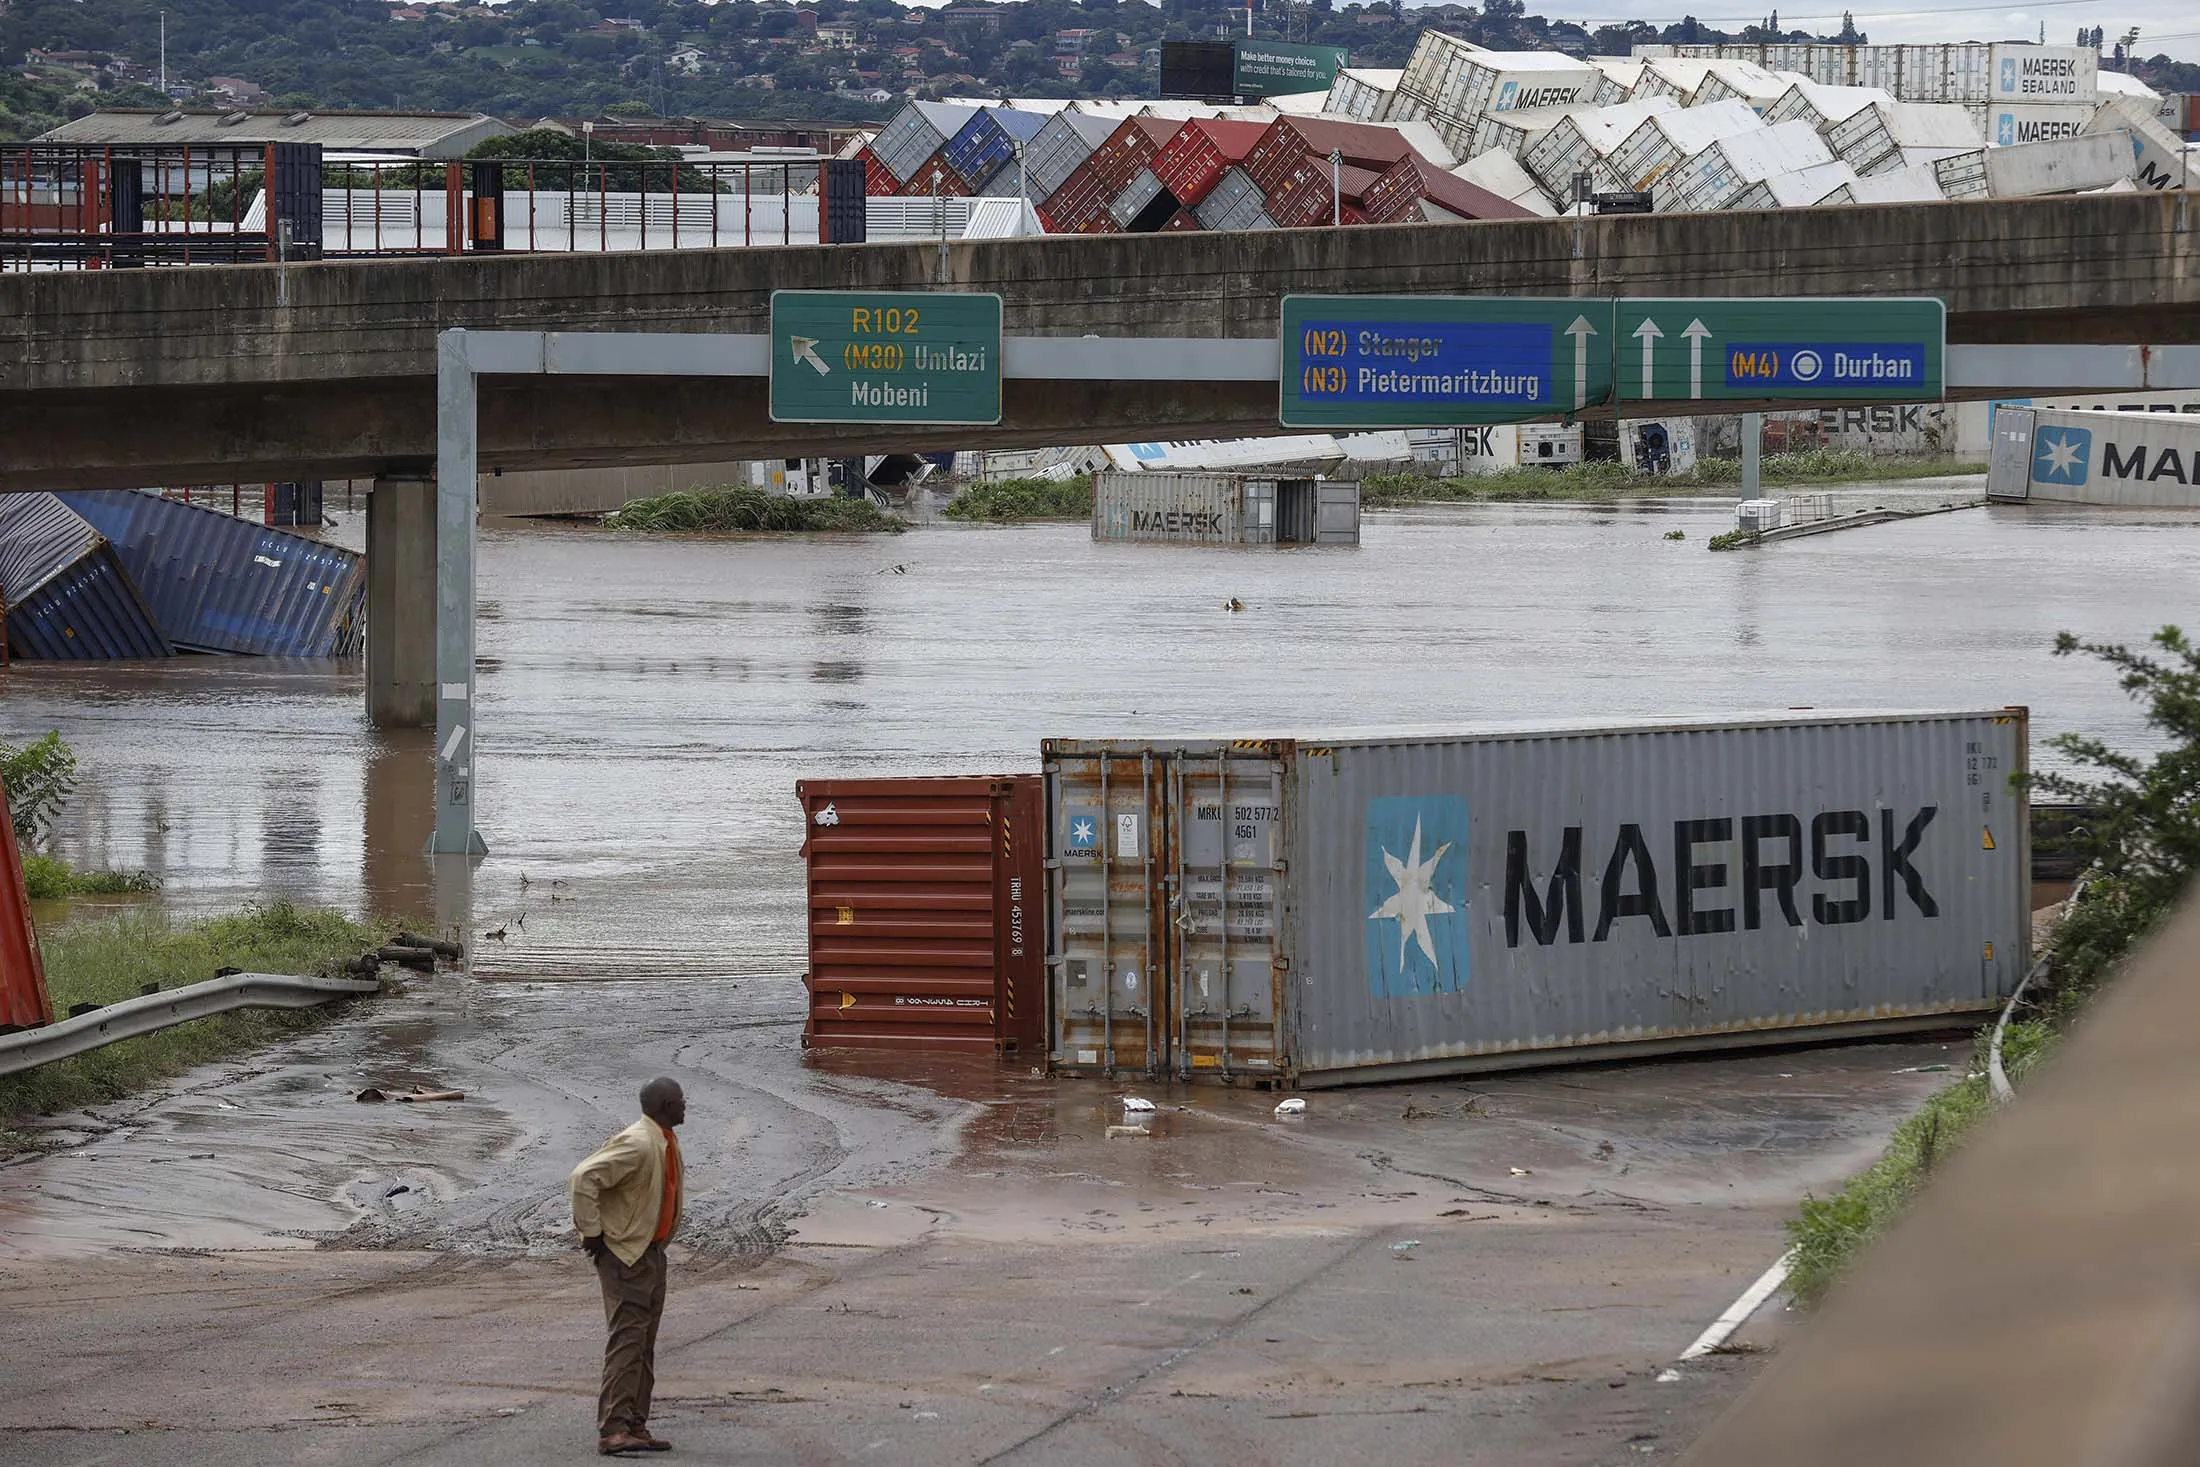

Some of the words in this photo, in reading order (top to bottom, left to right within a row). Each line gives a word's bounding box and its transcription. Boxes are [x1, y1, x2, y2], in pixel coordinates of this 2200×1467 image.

[1240, 51, 1256, 62] Make
[1257, 53, 1275, 63] better
[1276, 56, 1295, 66] money
[1295, 56, 1316, 67] choices
[1240, 64, 1253, 73] with
[1253, 65, 1269, 75] credit
[1270, 66, 1286, 76] that's
[1286, 68, 1306, 78] tailored
[1307, 69, 1315, 78] for
[2023, 58, 2075, 77] MAERSK
[1514, 87, 1581, 109] MAERSK
[2022, 80, 2076, 94] SEALAND
[2017, 121, 2080, 142] MAERSK
[852, 308, 920, 333] R102
[844, 343, 904, 371] (M30)
[915, 346, 985, 371] Umlazi
[1304, 329, 1347, 357] (N2)
[1358, 330, 1443, 363] Stanger
[1732, 352, 1779, 378] (M4)
[1834, 352, 1912, 378] Durban
[851, 381, 928, 407] Mobeni
[1303, 366, 1347, 394] (N3)
[1358, 368, 1539, 401] Pietermaritzburg
[2102, 442, 2200, 486] MA
[1132, 510, 1223, 535] MAERSK
[1235, 807, 1252, 821] 502
[1254, 807, 1271, 821] 577
[1235, 825, 1257, 839] 45G1
[1064, 849, 1104, 858] MAERSK
[1010, 877, 1022, 901] TRHU
[1503, 805, 1940, 949] MAERSK
[1011, 905, 1023, 943] 453769
[1010, 948, 1023, 956] 8
